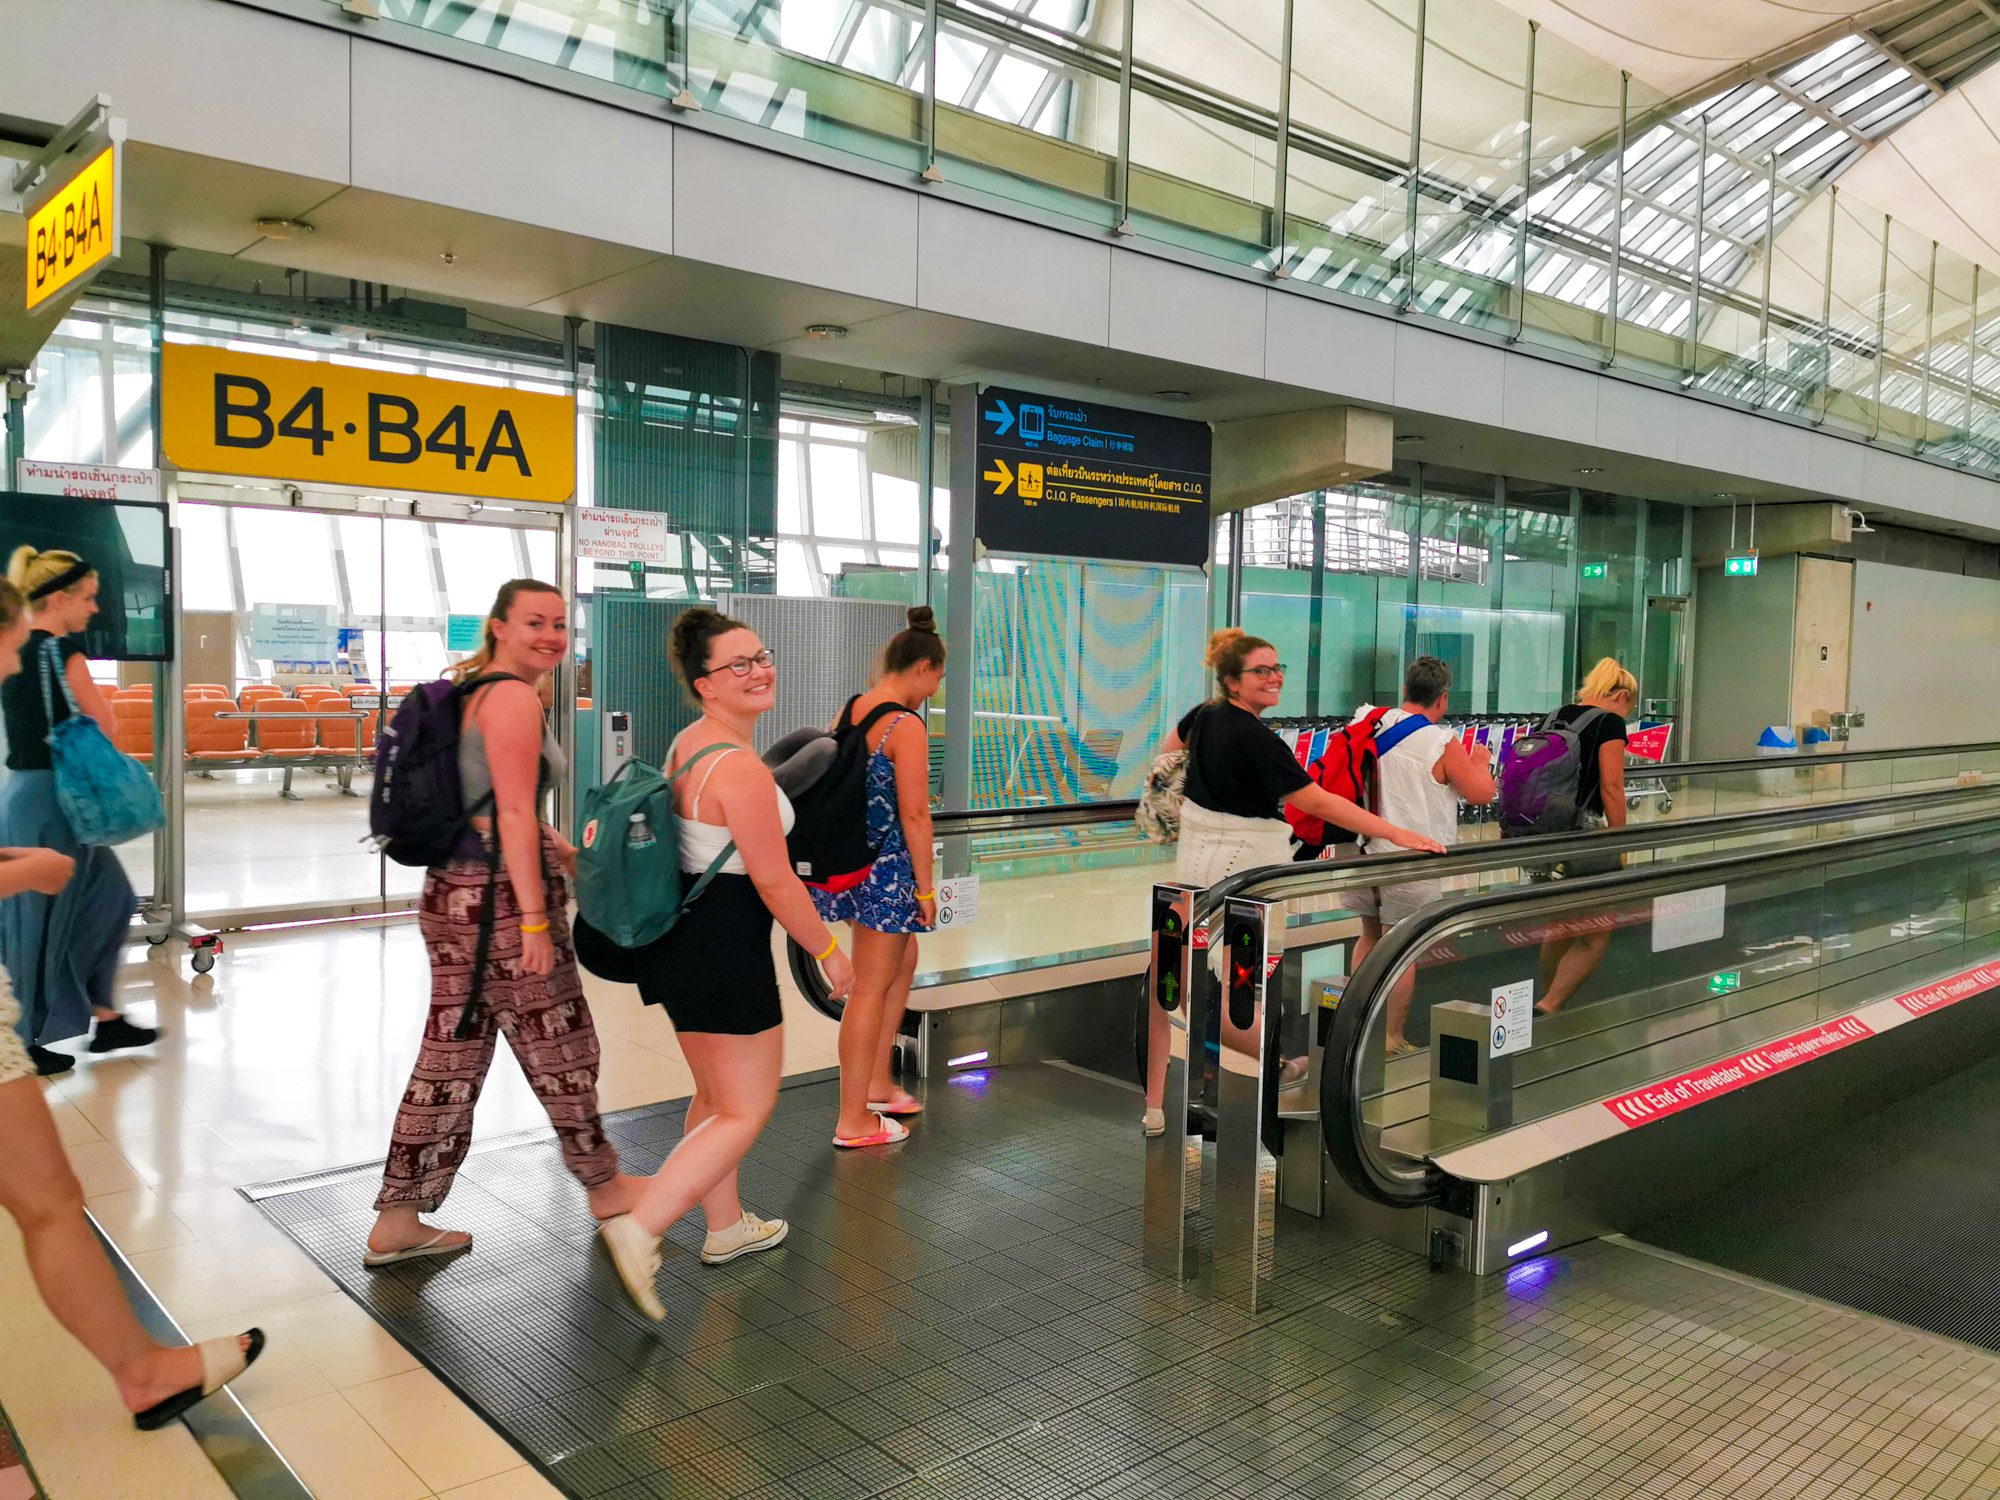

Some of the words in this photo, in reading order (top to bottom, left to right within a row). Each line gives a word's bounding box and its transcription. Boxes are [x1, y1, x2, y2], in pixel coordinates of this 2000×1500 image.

[1047, 430, 1082, 447] Baggage
[1082, 435, 1104, 449] Claim
[62, 483, 118, 499] ผ่านจดนี้
[1183, 482, 1203, 495] C.I.Q.
[1045, 489, 1069, 502] C.I.Q.
[1070, 491, 1114, 508] Passengers
[578, 538, 590, 546] NO
[591, 539, 627, 549] HANDBAG
[629, 542, 664, 551] TROLLEYS
[583, 547, 616, 557] BEYOND
[618, 550, 636, 558] THIS
[637, 551, 660, 560] POINT
[1936, 986, 1950, 1000] of
[1940, 978, 1979, 997] Travelator
[1918, 990, 1942, 1005] End
[1644, 1087, 1680, 1109] End
[1674, 1082, 1692, 1100] of
[1683, 1065, 1745, 1094] Travelator
